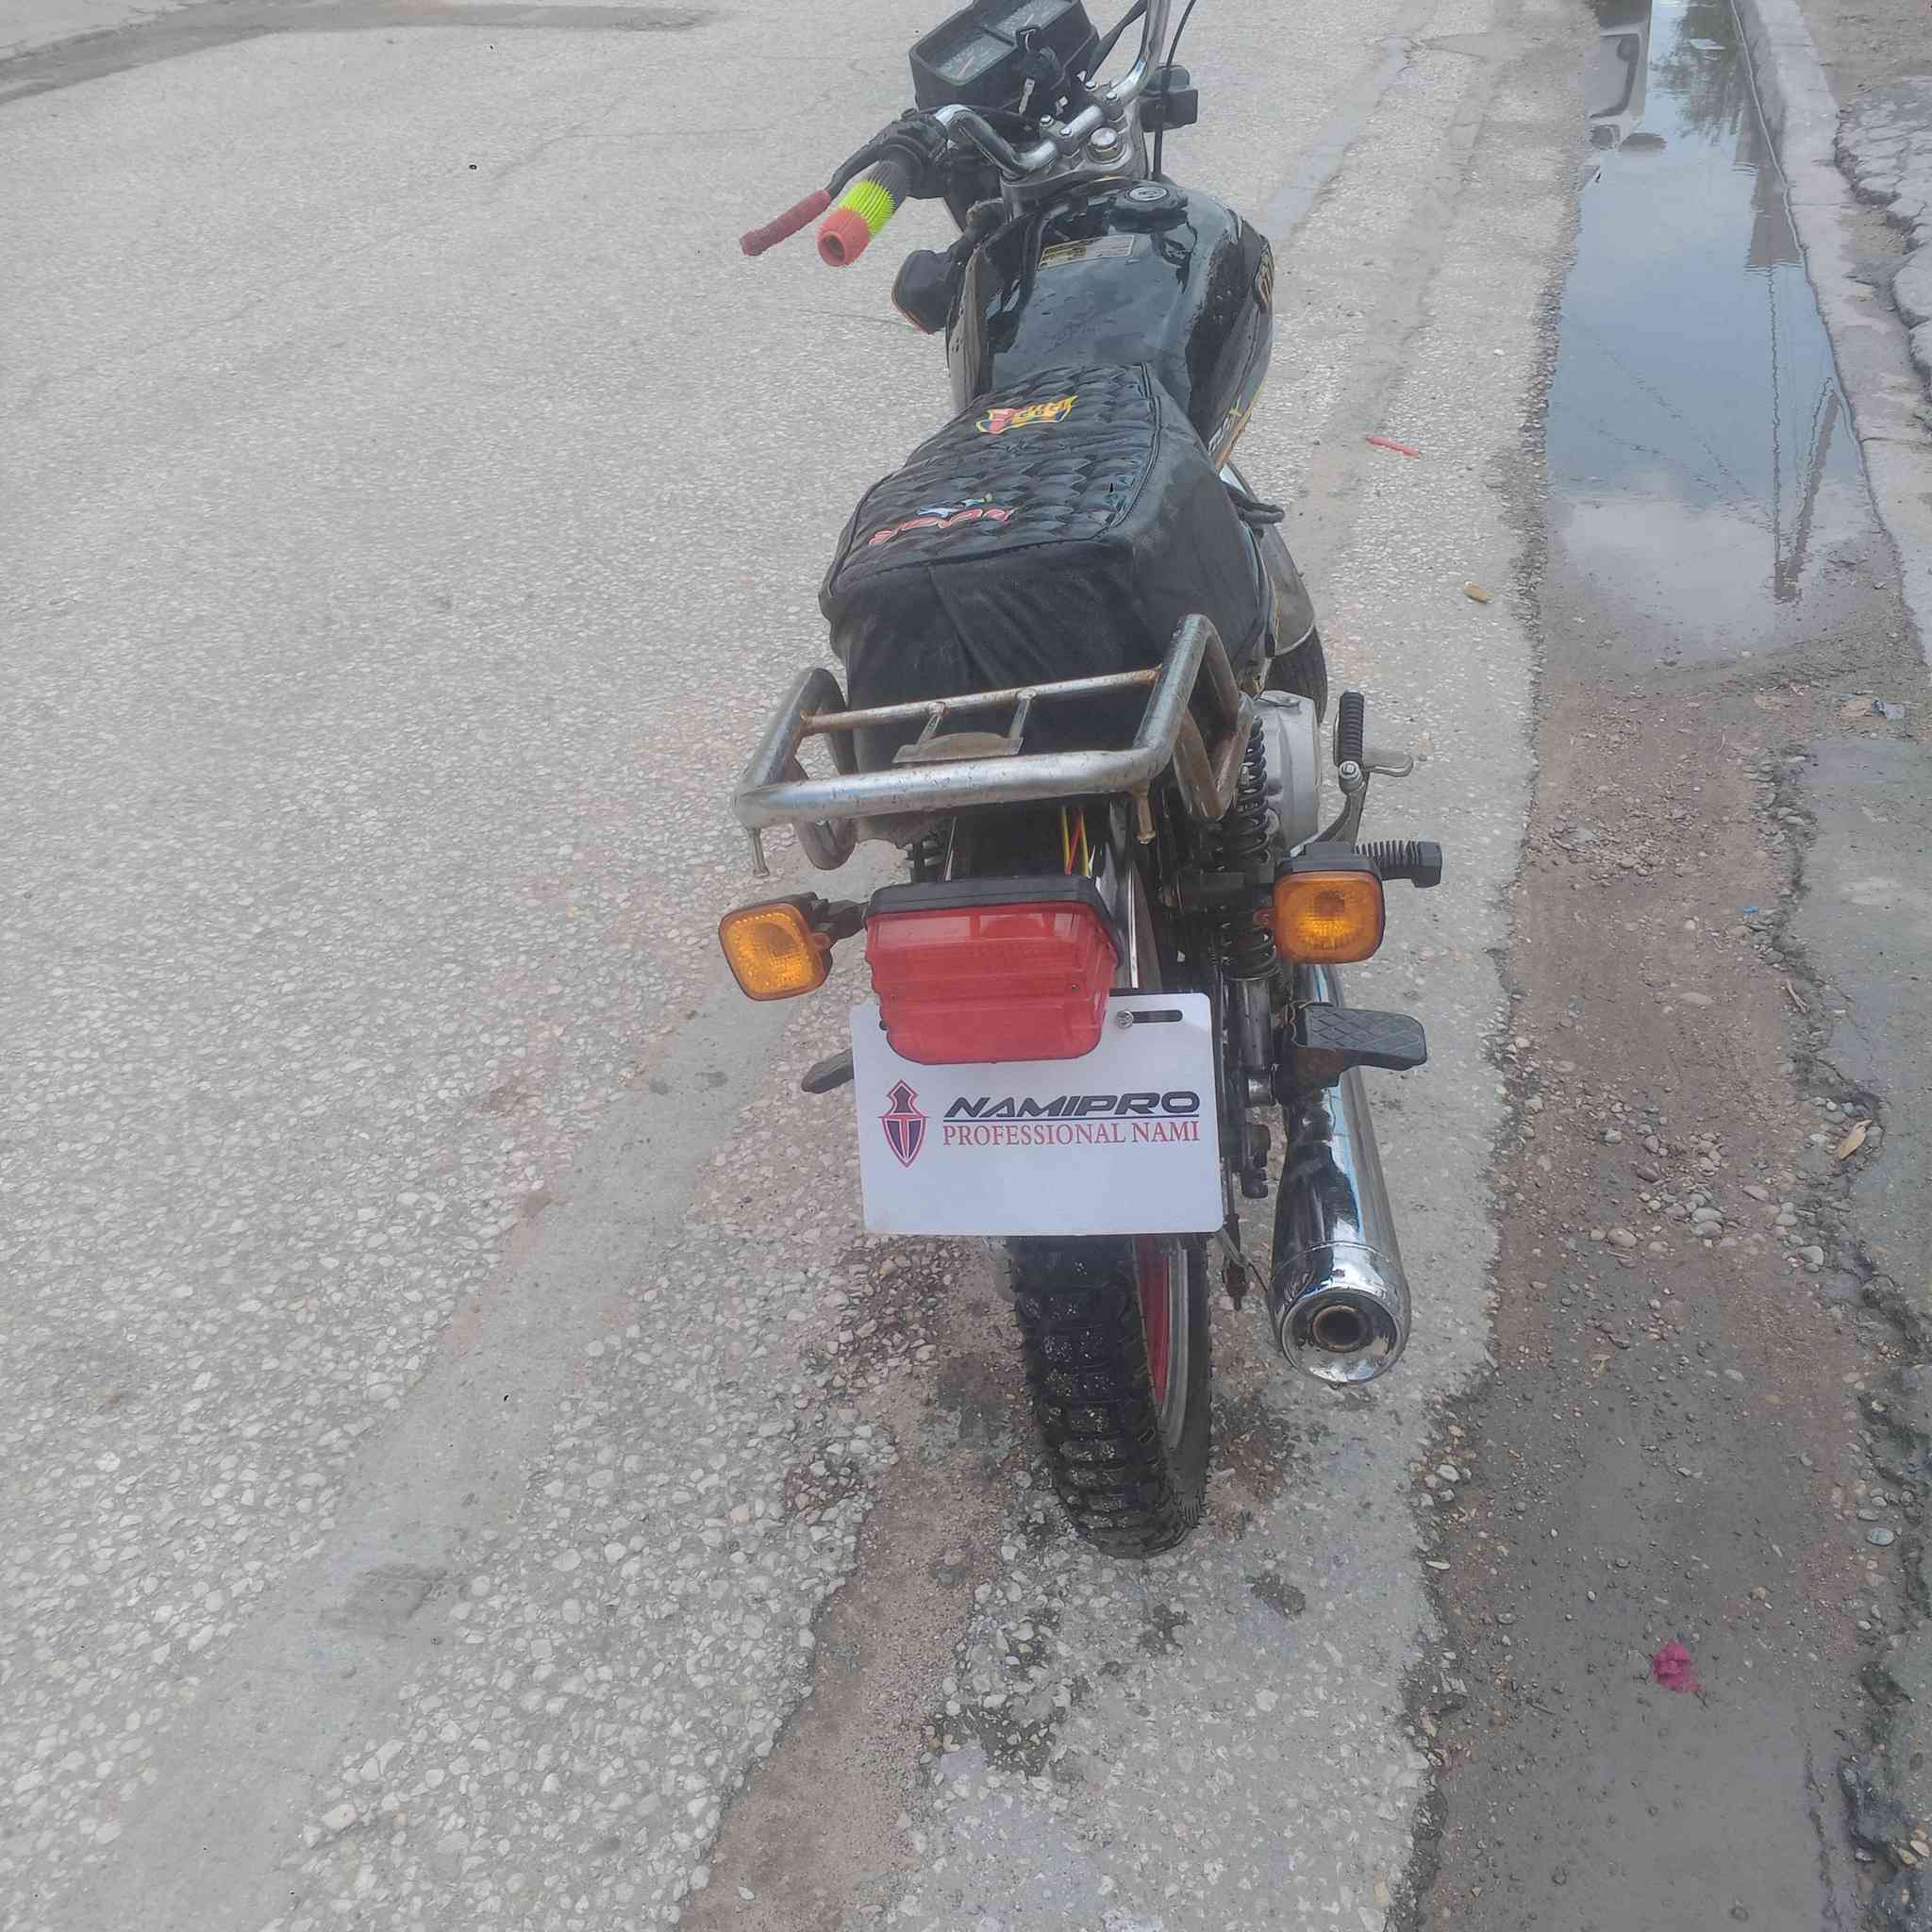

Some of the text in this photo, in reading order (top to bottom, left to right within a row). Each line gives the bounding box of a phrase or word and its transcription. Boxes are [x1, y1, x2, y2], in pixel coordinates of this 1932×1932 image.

[943, 1091, 1200, 1118] NAMIPRO
[943, 1121, 1200, 1146] PROFESSIONAL NAMI
